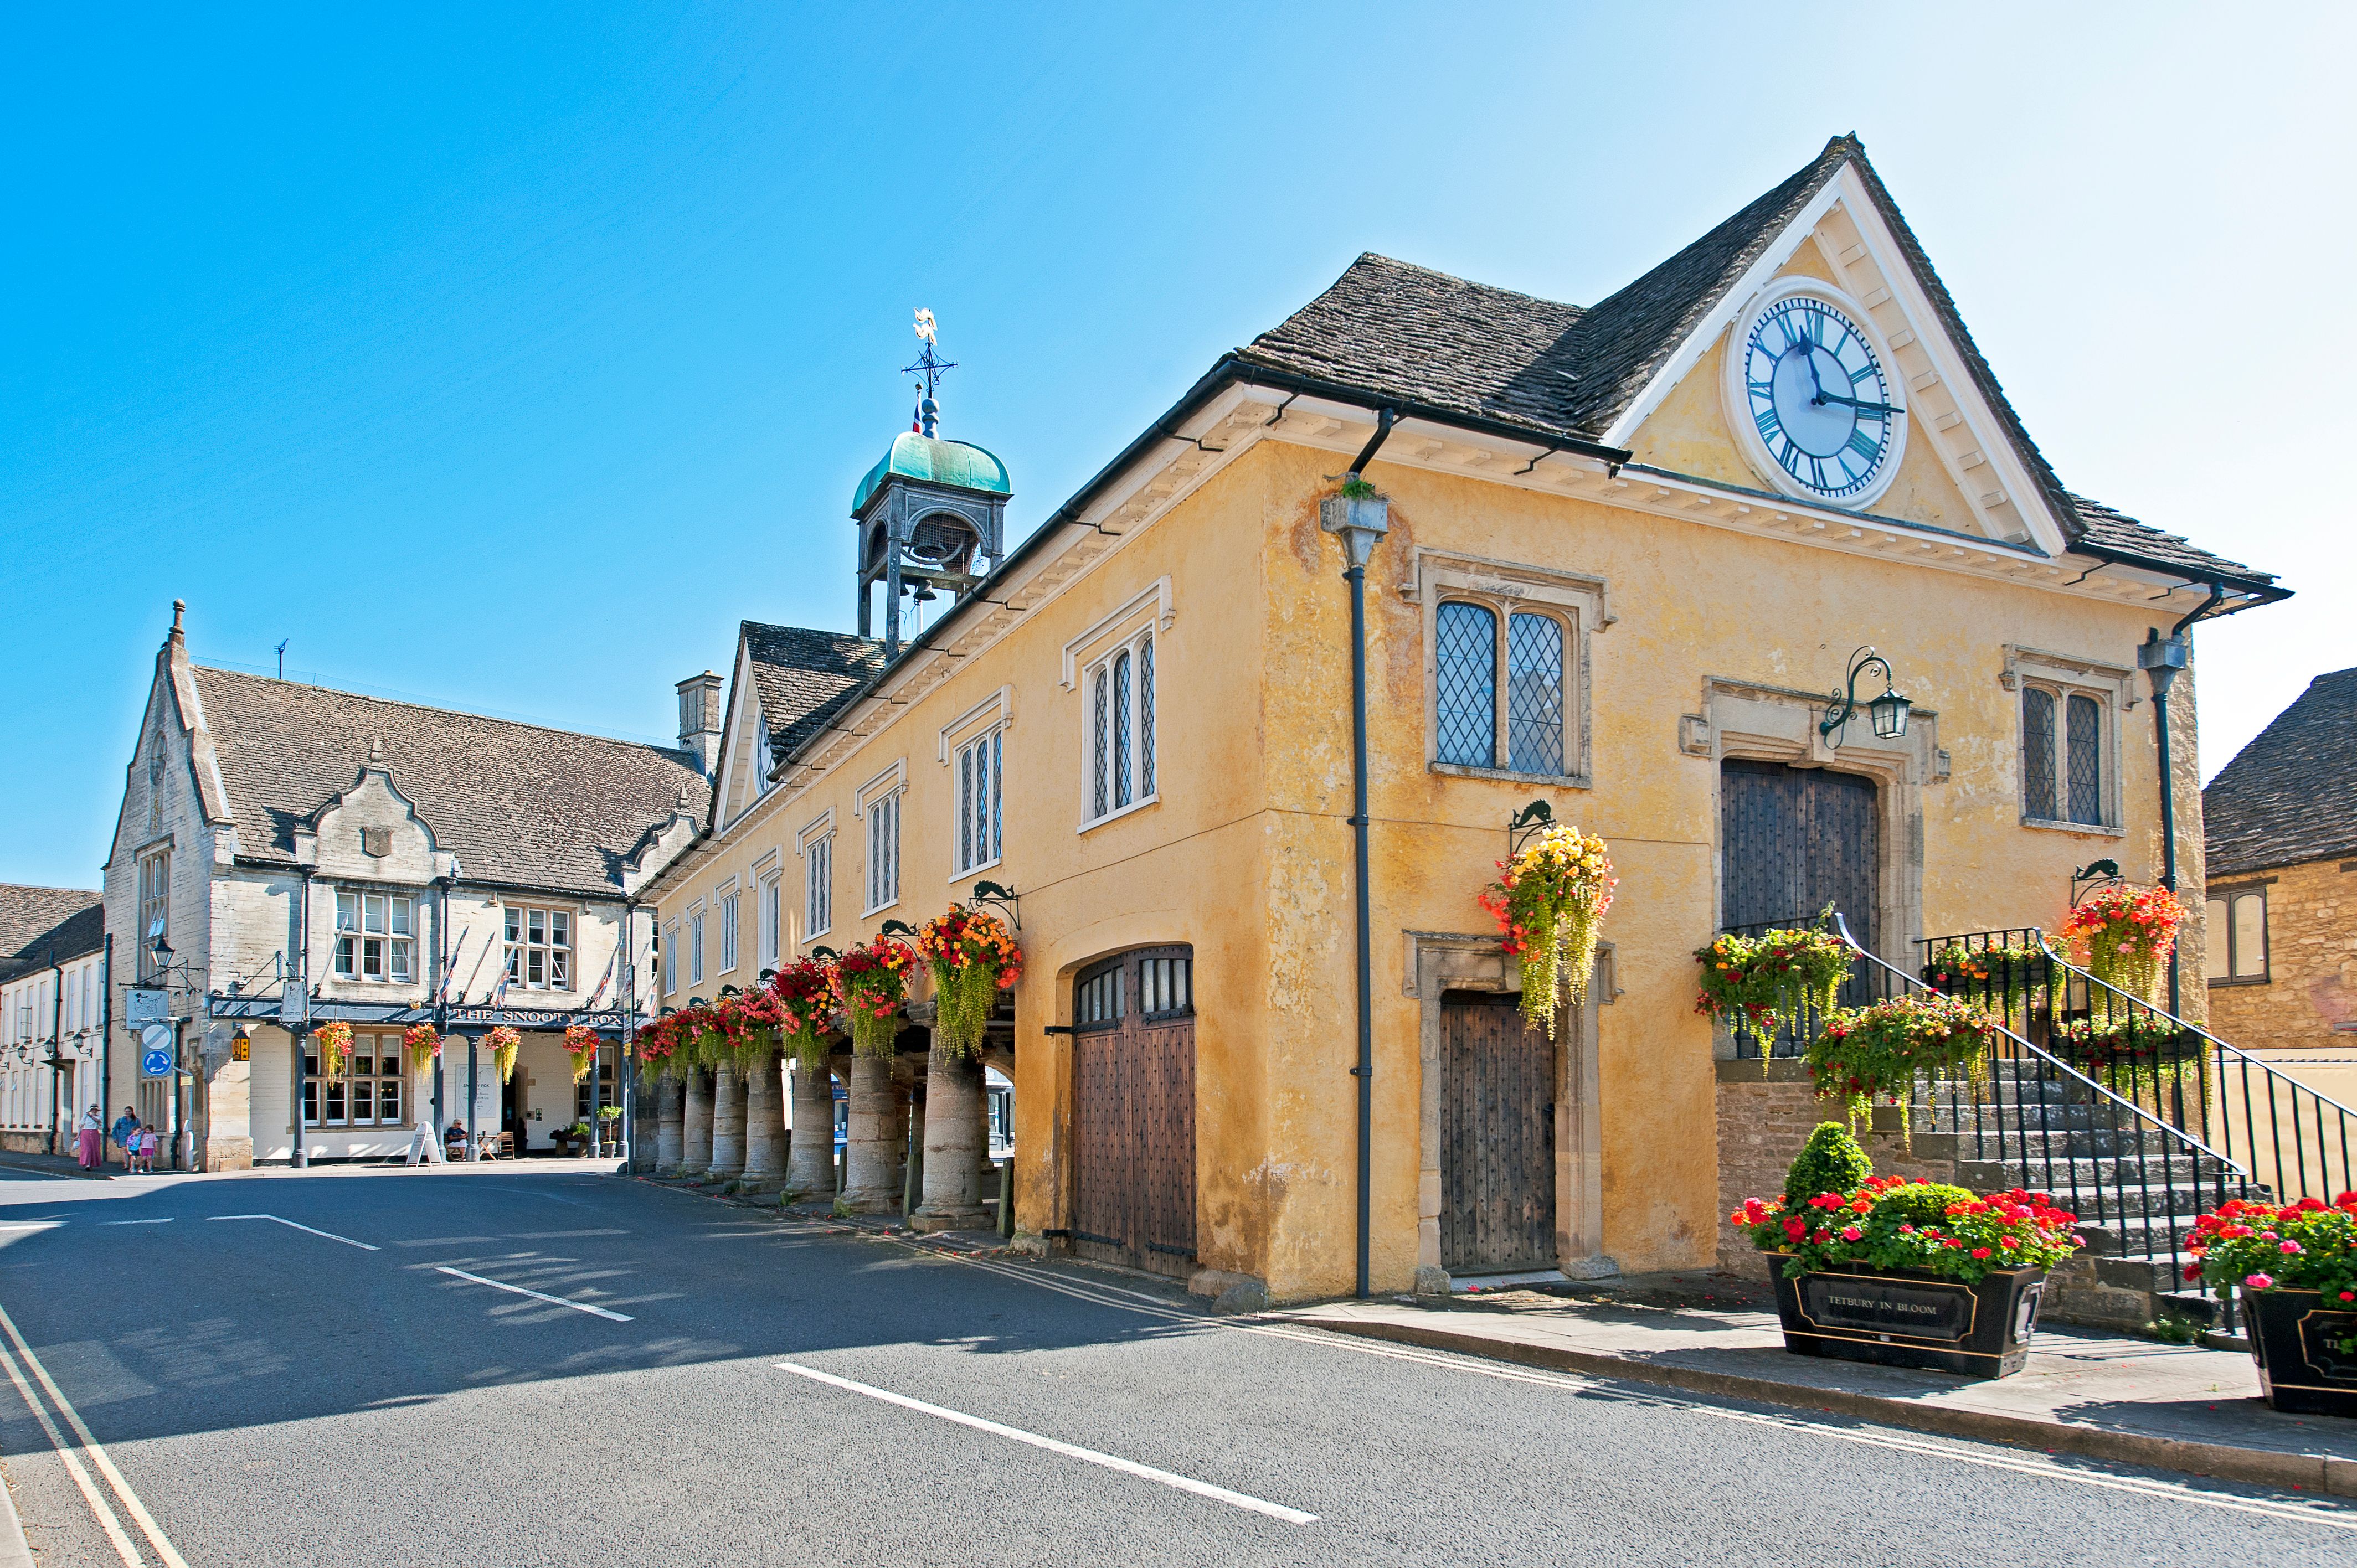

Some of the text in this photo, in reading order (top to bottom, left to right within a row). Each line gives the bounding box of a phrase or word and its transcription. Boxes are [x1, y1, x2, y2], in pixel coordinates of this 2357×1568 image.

[452, 1009, 624, 1025] THE SNOOTY FOX
[1828, 1296, 1937, 1315] TETBURY IN BLOOM
